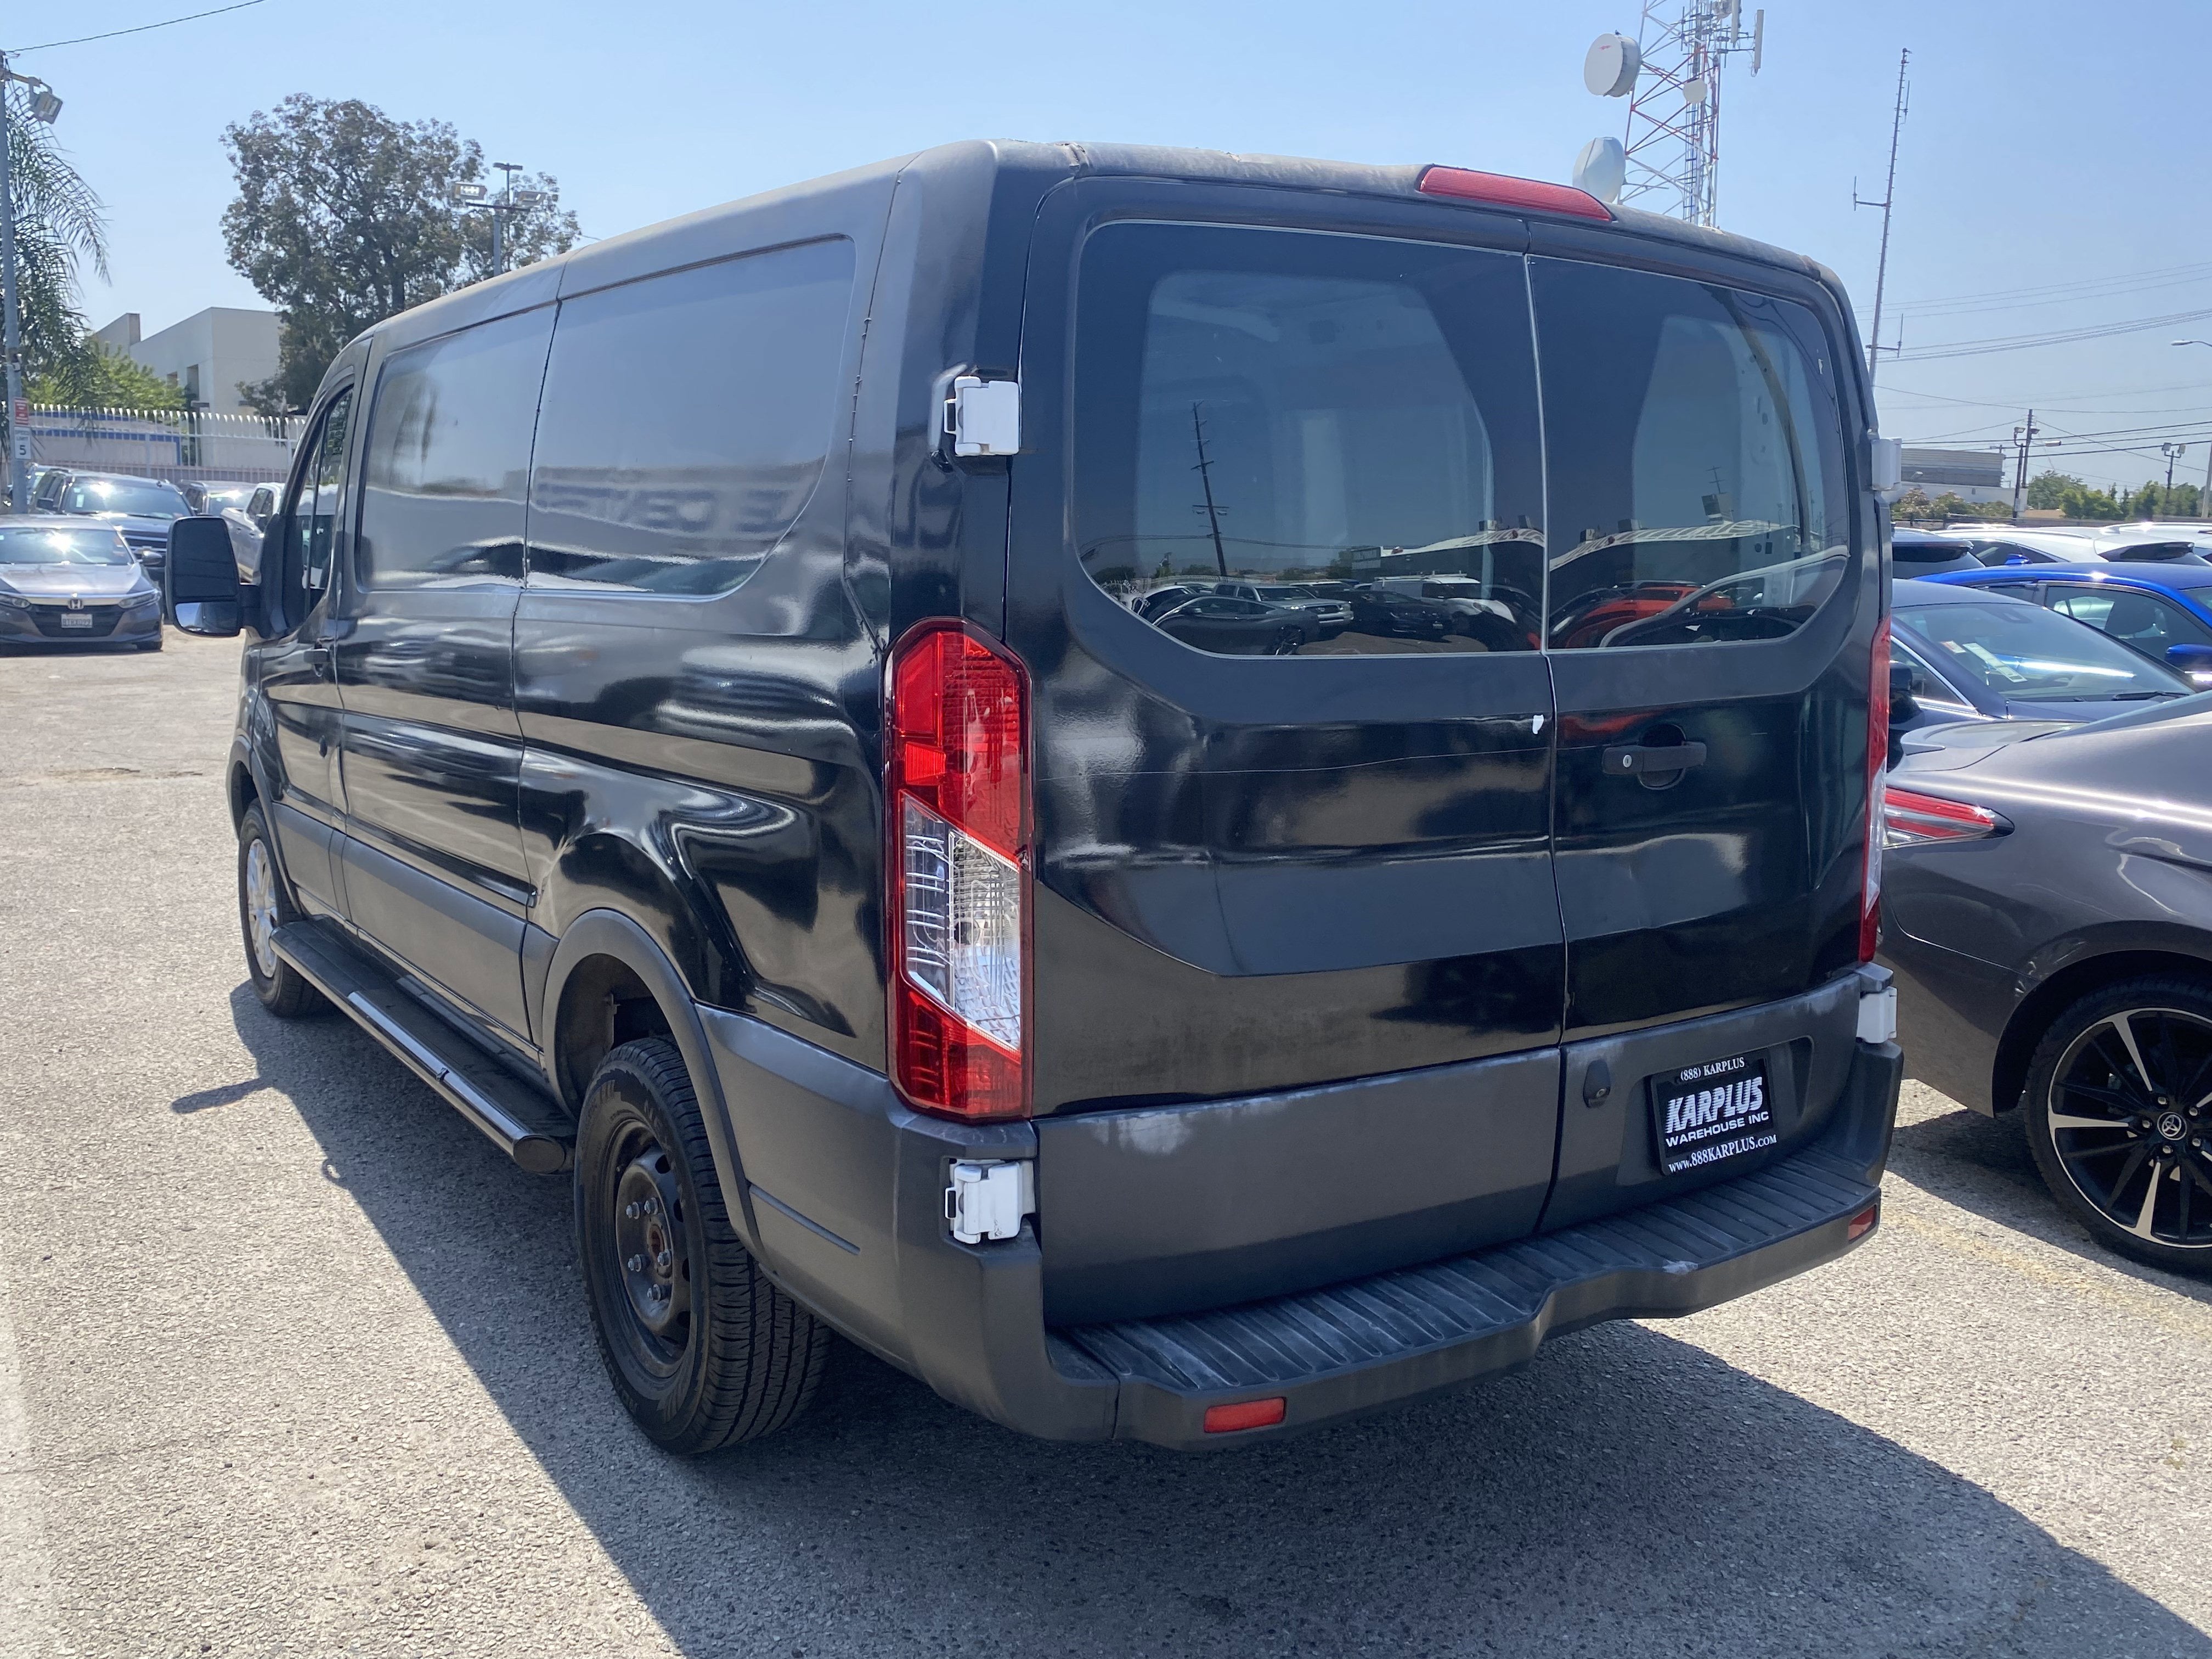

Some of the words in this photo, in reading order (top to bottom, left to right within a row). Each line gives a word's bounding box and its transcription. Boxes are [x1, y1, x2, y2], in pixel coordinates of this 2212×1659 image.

[20, 445, 26, 455] 5
[1680, 1067, 1701, 1081] (888)
[1703, 1057, 1745, 1076] KARPLUS
[1666, 1076, 1762, 1133] KARPLUS
[1666, 1118, 1745, 1147] WAREHOUSE
[1748, 1111, 1769, 1125] INC
